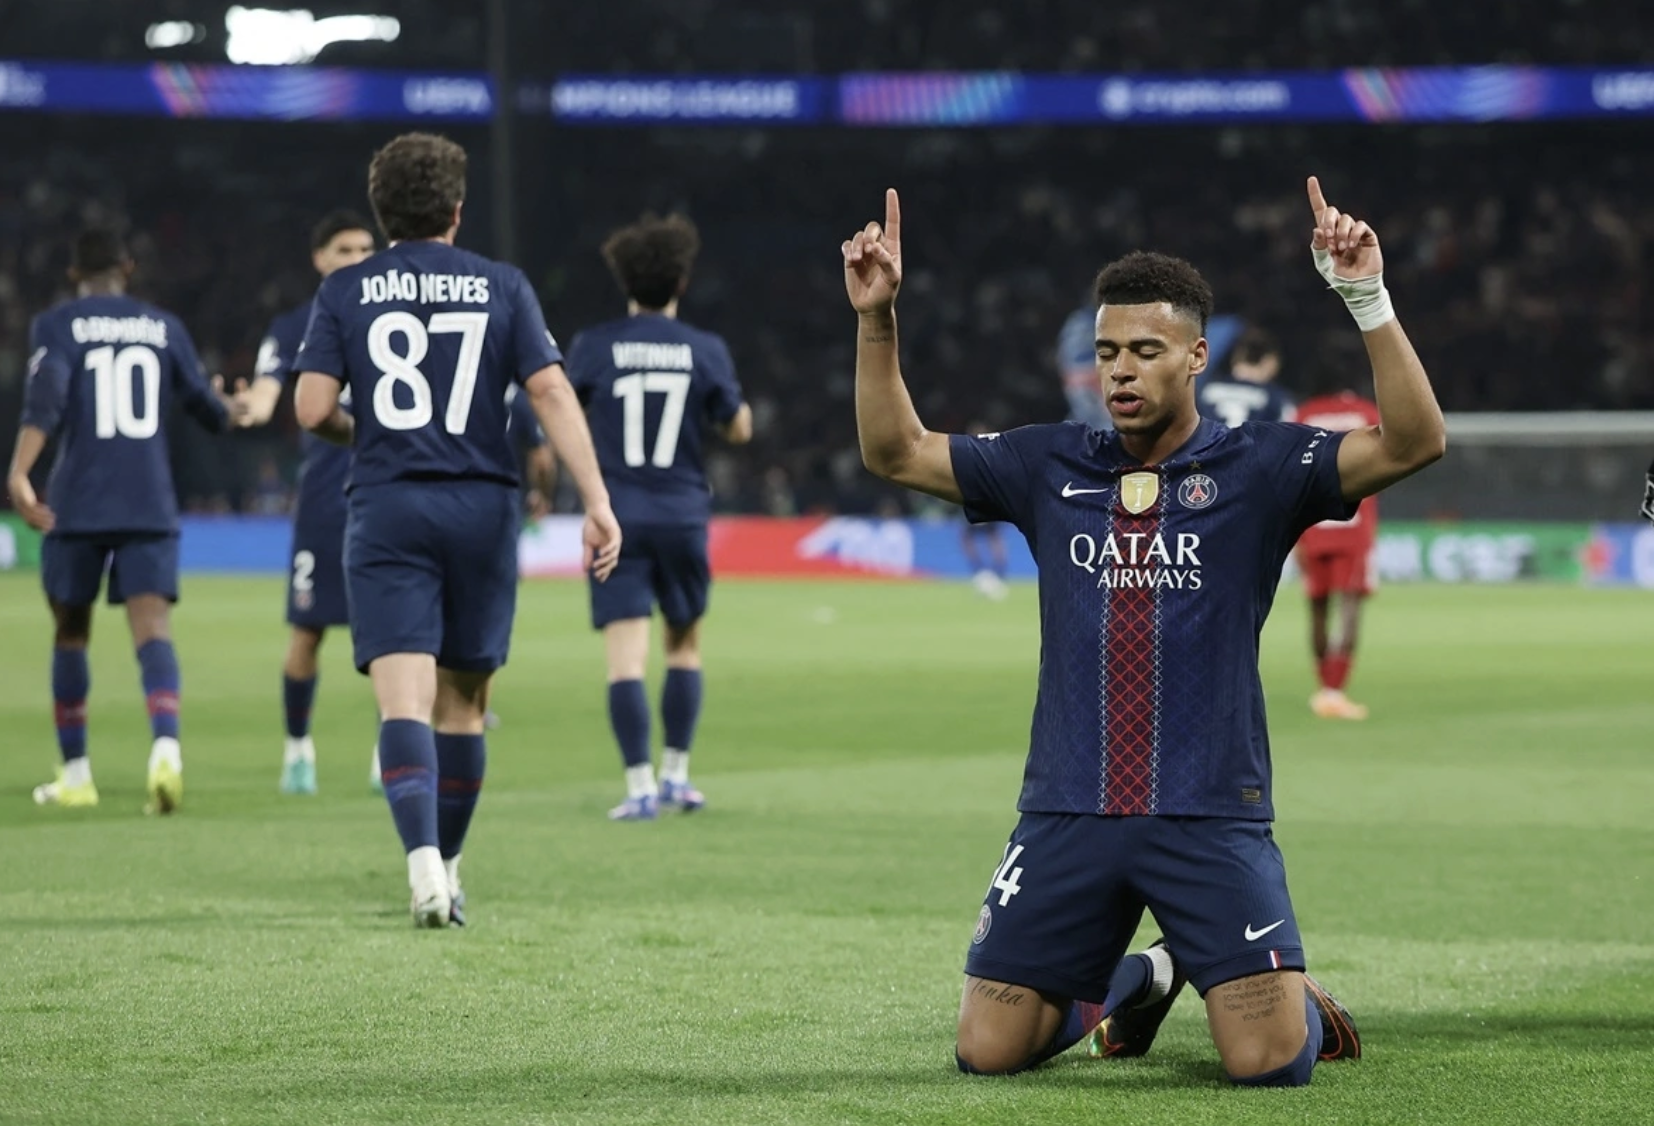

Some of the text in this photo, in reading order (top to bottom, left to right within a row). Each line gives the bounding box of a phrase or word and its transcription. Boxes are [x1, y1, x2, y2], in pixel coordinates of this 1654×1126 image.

[359, 269, 490, 305] JOÃO NEVES
[84, 345, 161, 439] 10
[367, 311, 490, 435] 87
[612, 371, 692, 468] 17
[1182, 475, 1212, 487] PARIS
[293, 549, 315, 592] 2
[1070, 532, 1202, 573] QATAR
[1097, 568, 1202, 590] AIRWAYS
[986, 842, 1025, 907] 4
